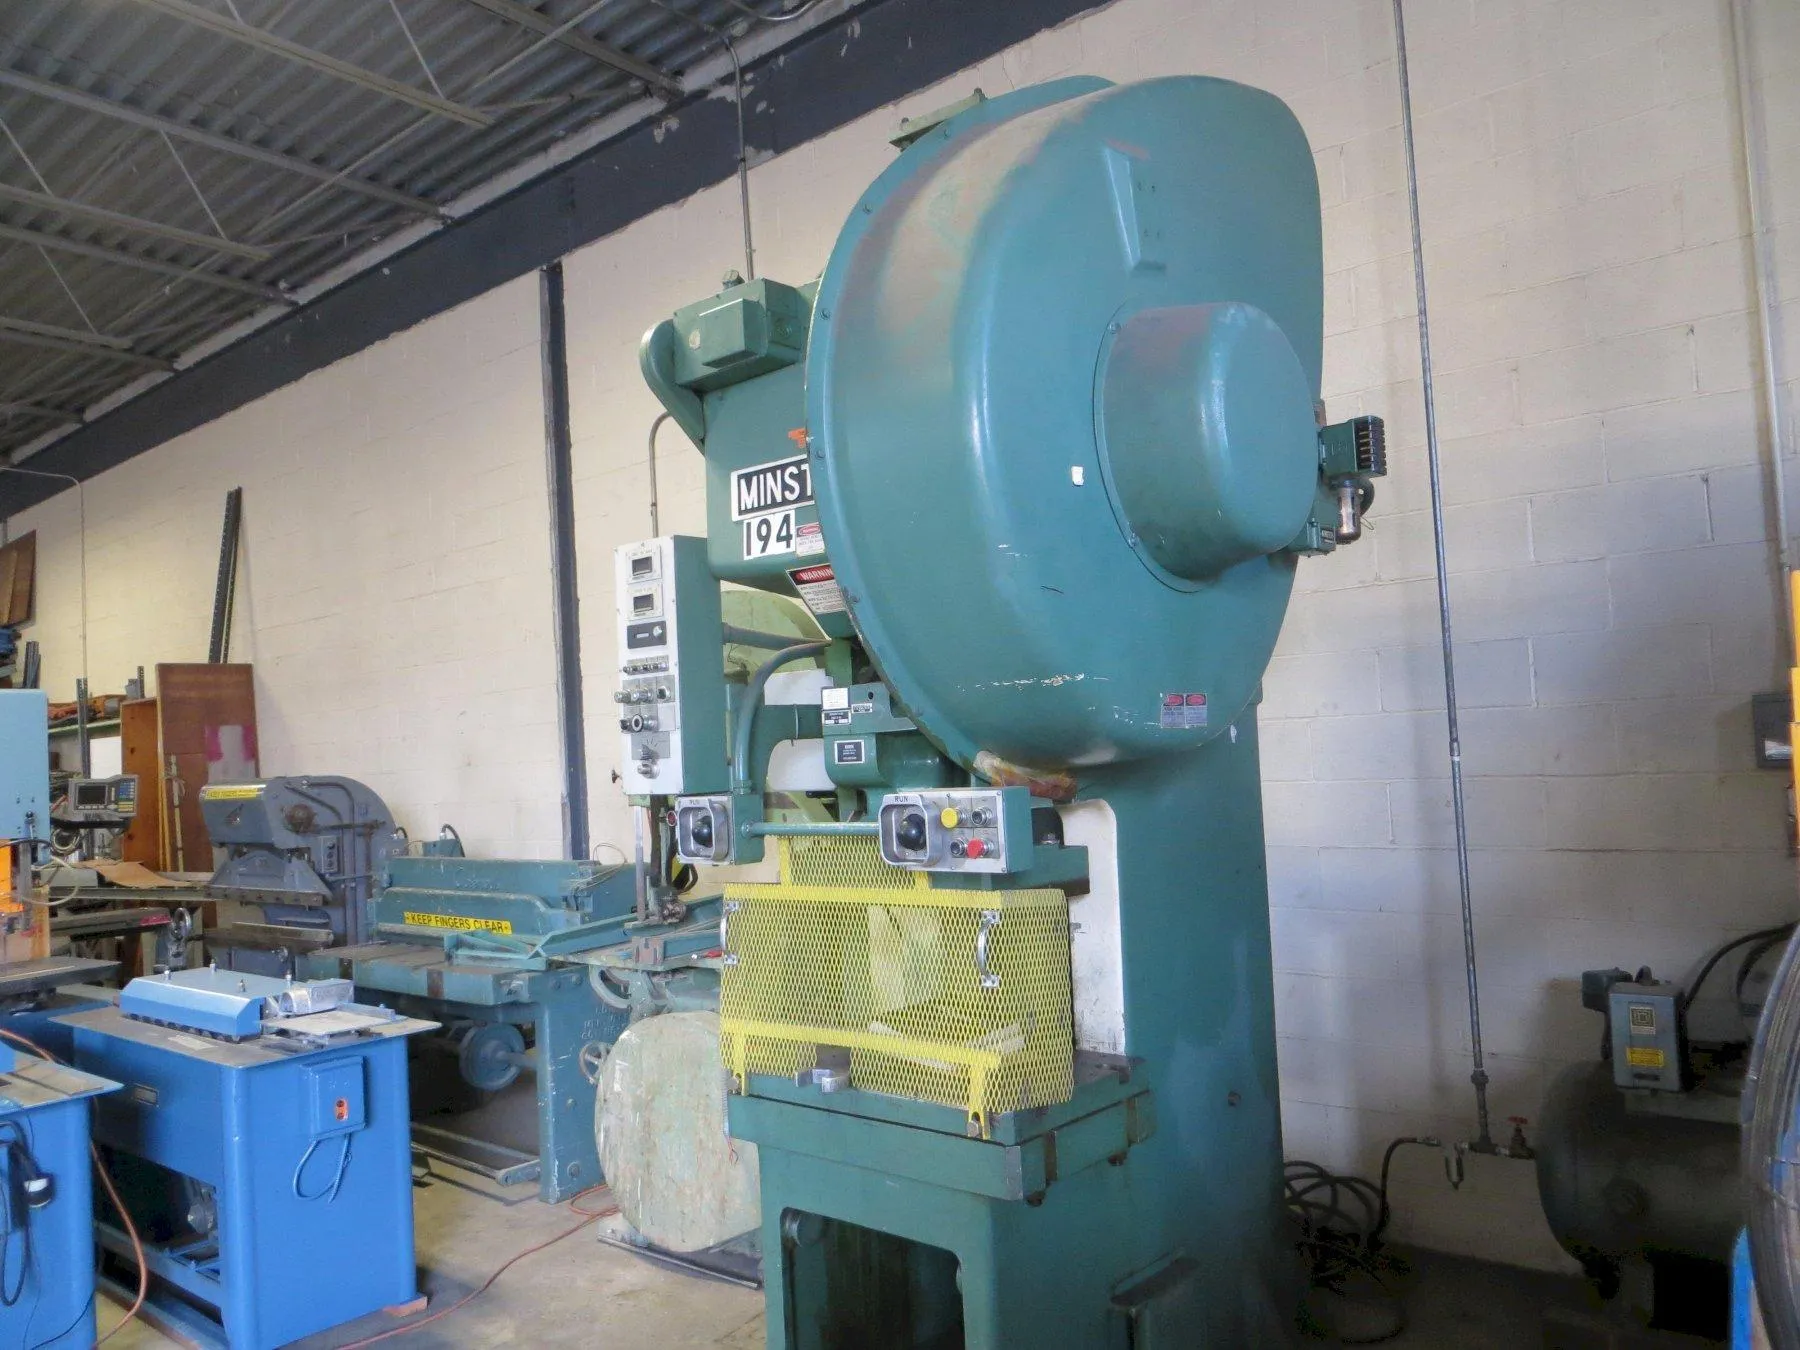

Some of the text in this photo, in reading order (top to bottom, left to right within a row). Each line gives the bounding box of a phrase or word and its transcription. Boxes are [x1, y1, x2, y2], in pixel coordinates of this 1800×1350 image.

[746, 513, 793, 557] 194
[411, 912, 432, 925] KEEP
[435, 915, 471, 930] FINGERS
